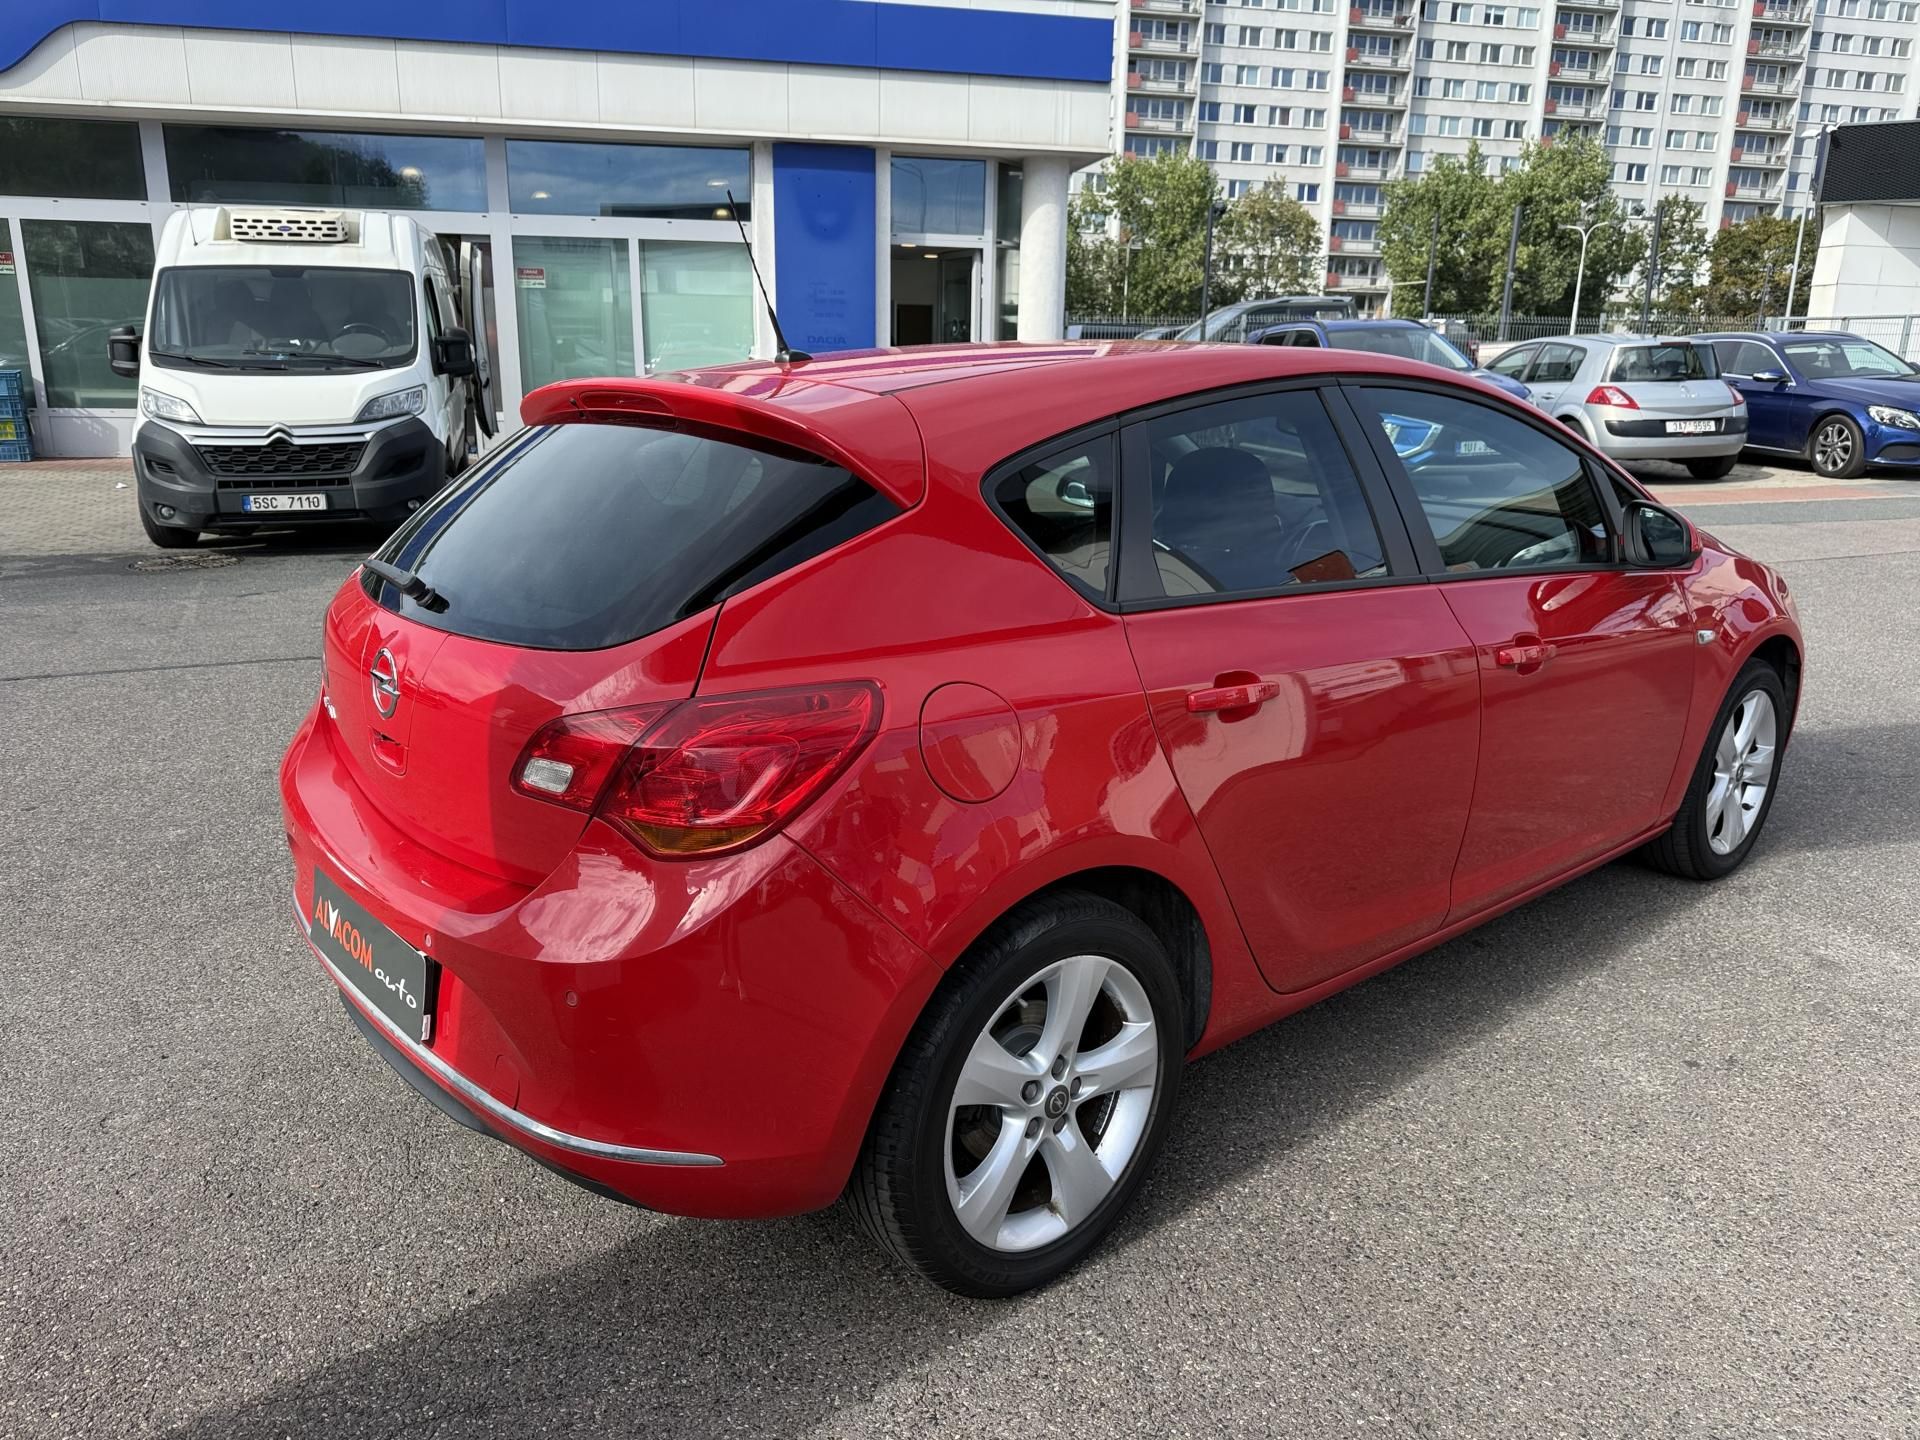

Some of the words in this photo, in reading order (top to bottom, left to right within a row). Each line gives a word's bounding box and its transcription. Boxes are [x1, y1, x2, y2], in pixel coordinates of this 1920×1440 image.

[807, 335, 848, 345] DACIA
[253, 496, 278, 509] 5SC
[287, 496, 320, 509] 7110
[374, 967, 417, 1009] auto
